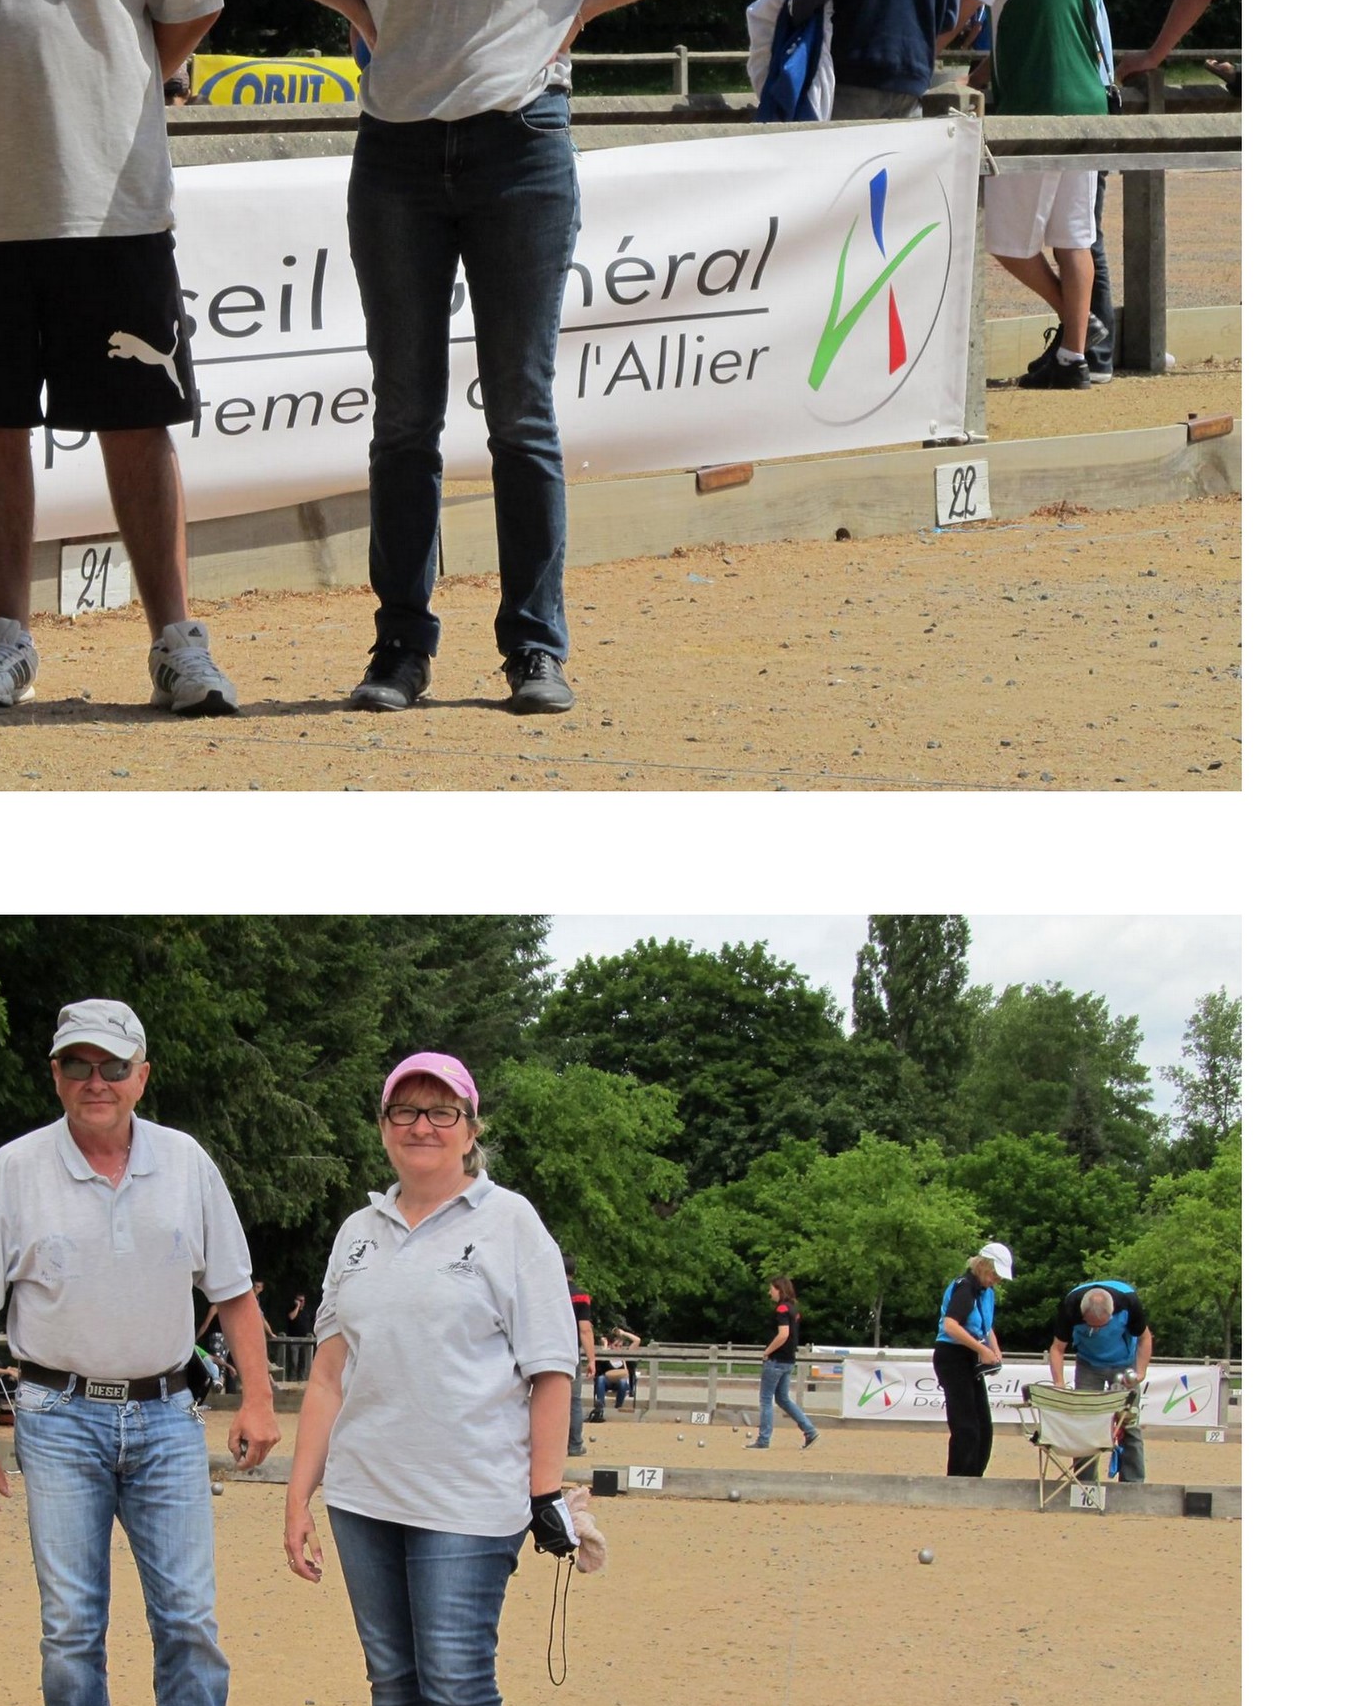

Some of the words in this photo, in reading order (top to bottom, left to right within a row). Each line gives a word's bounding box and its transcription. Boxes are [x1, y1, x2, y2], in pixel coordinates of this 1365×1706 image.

[578, 333, 770, 399] l'Allier
[948, 465, 977, 520] 22
[76, 546, 112, 610] 21
[636, 1469, 657, 1487] 17
